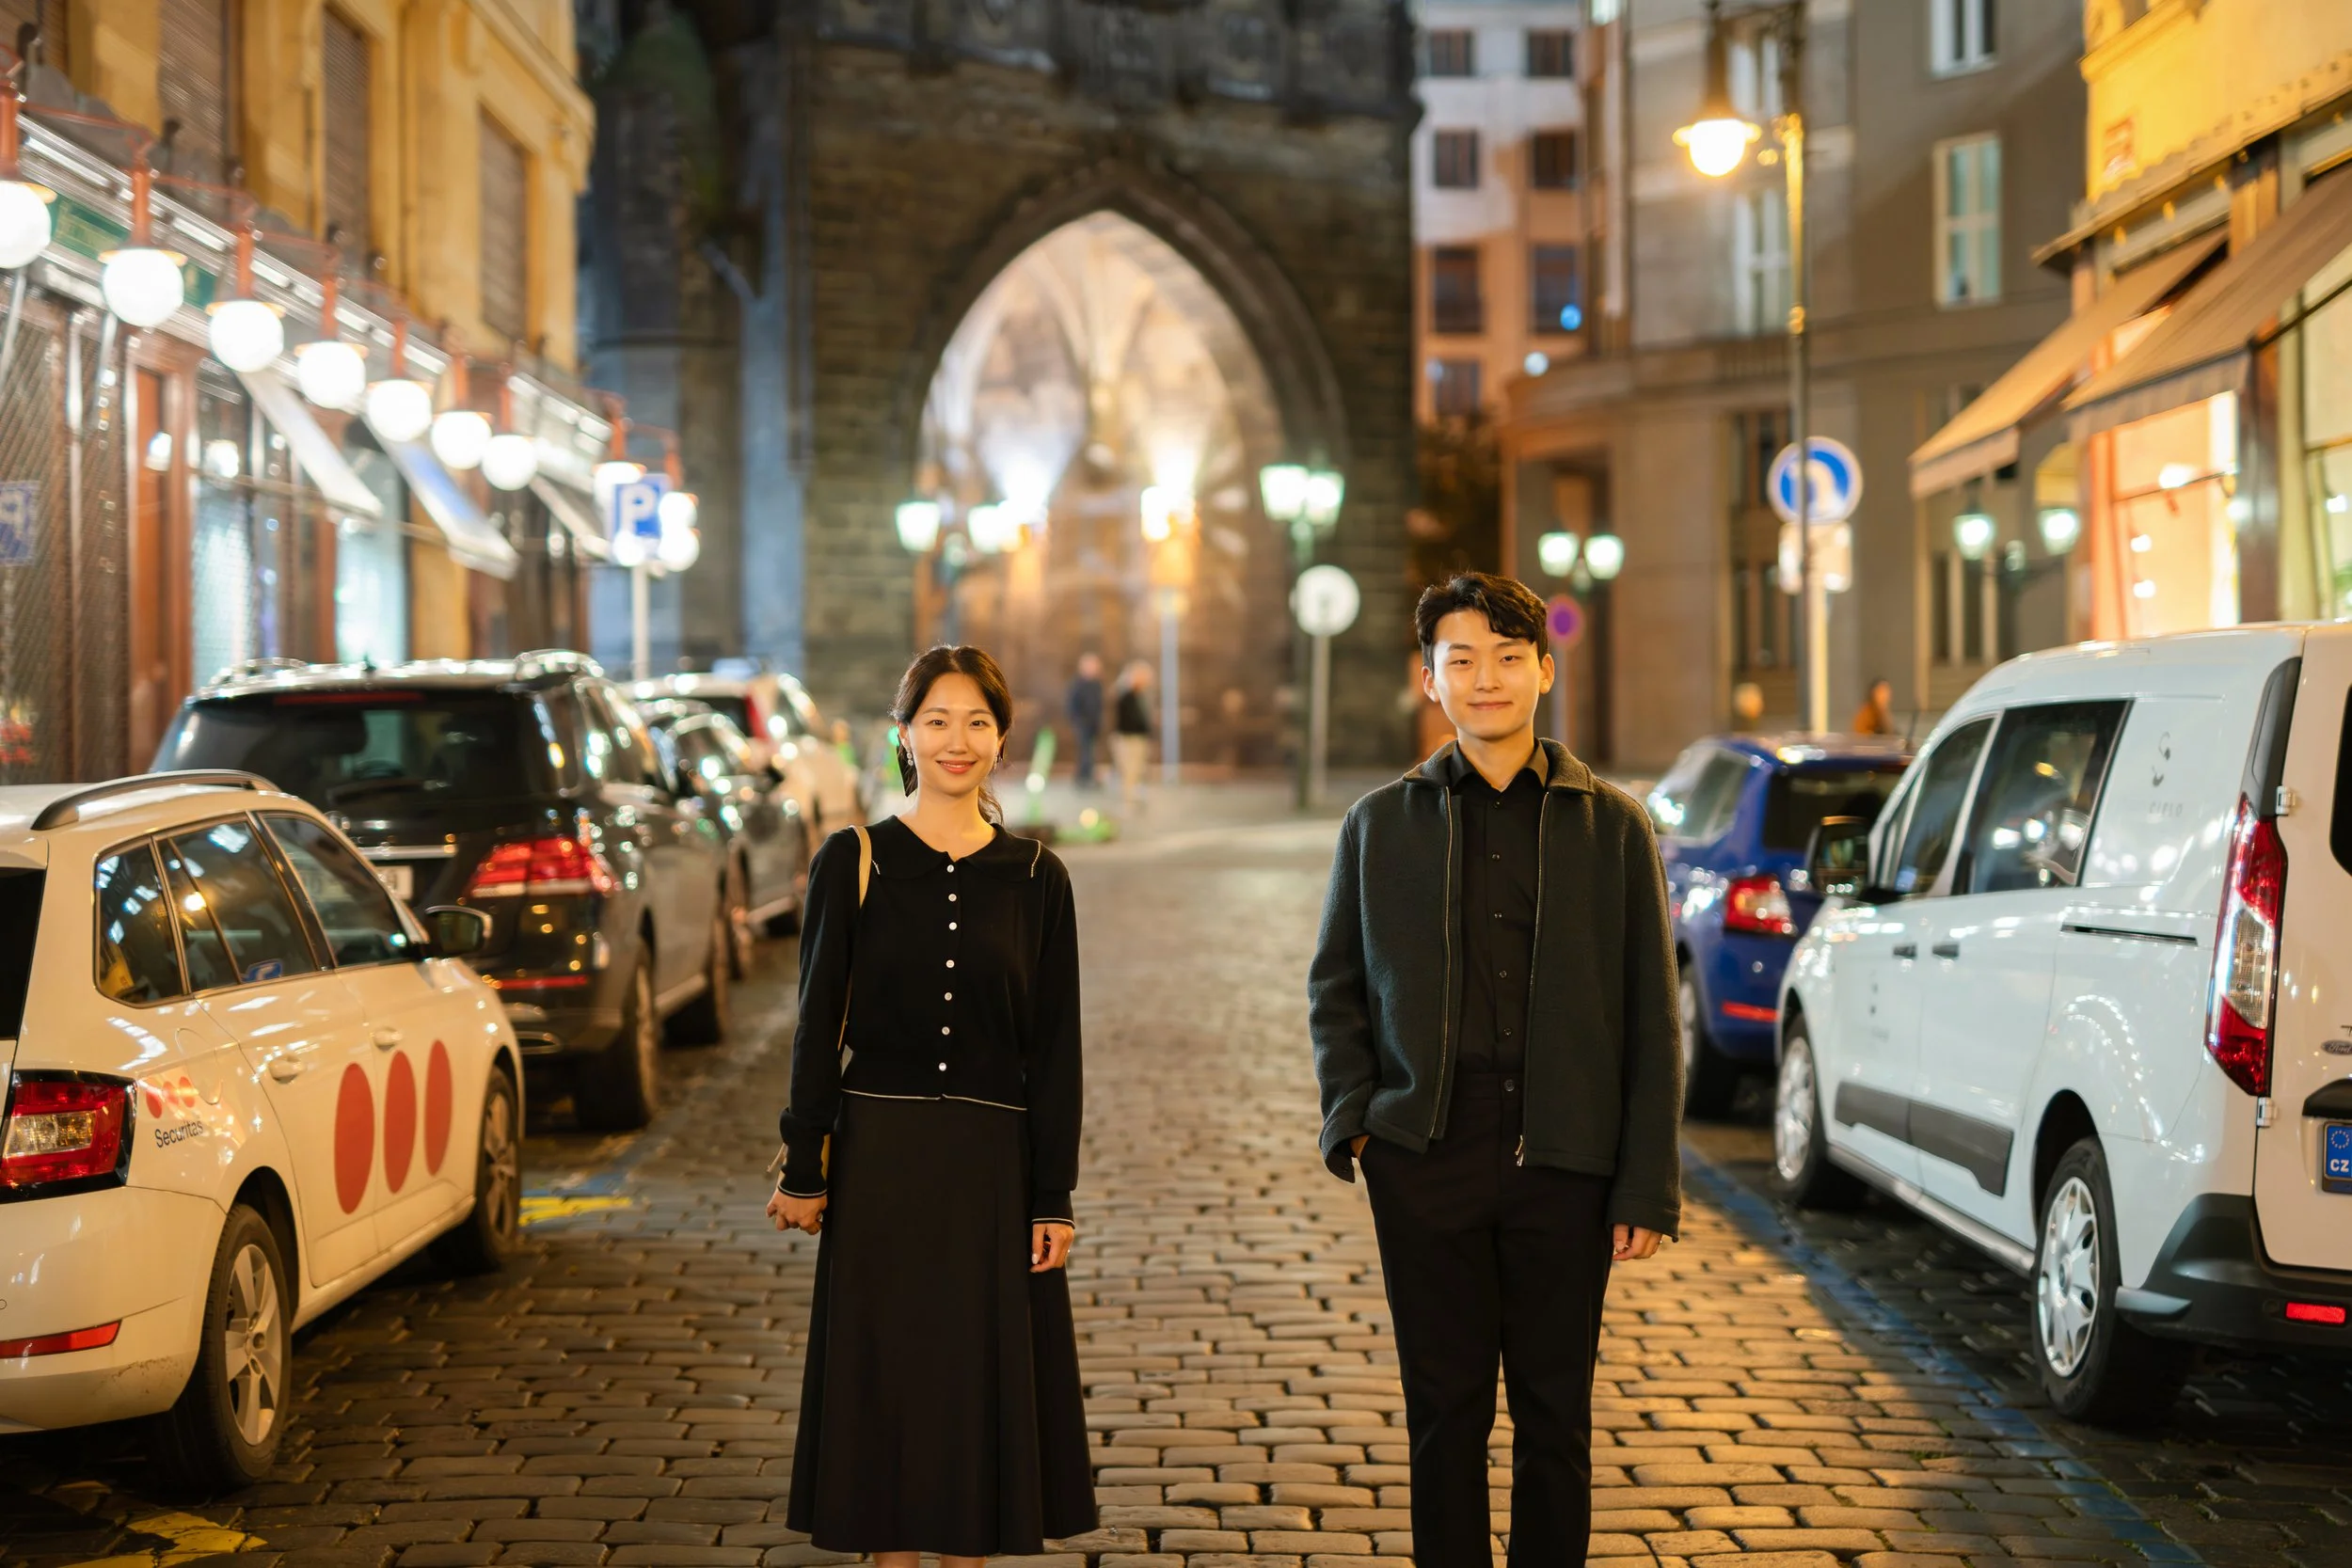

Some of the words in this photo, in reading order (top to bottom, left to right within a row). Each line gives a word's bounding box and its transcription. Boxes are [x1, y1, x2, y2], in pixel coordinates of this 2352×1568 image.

[622, 485, 654, 540] P
[154, 1120, 203, 1148] Securitas
[2330, 1159, 2349, 1172] CZ
